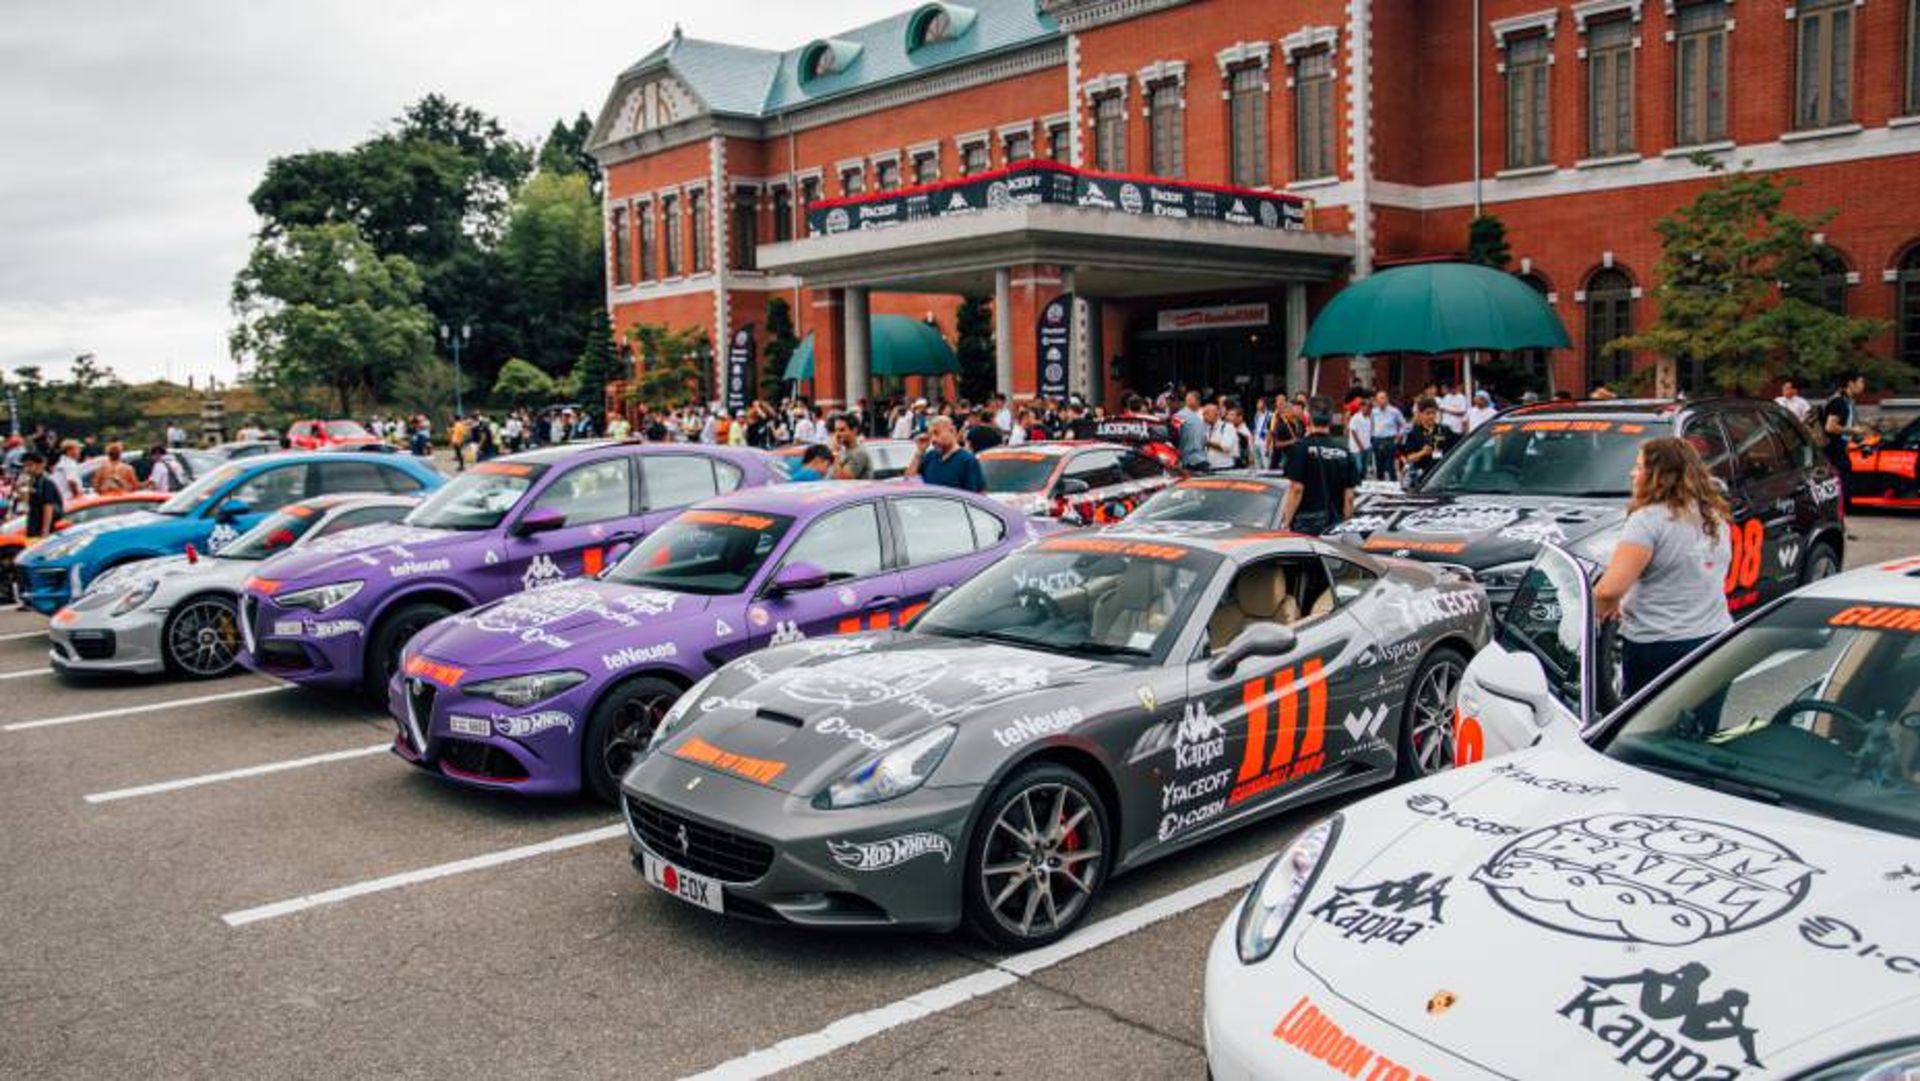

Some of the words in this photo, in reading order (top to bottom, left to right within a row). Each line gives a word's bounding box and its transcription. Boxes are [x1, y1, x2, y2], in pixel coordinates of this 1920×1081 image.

[603, 642, 677, 670] teNeues
[992, 706, 1086, 748] teNeues
[1175, 737, 1225, 771] Kappa
[1308, 893, 1425, 946] Kappa
[1273, 996, 1374, 1079] LONDON
